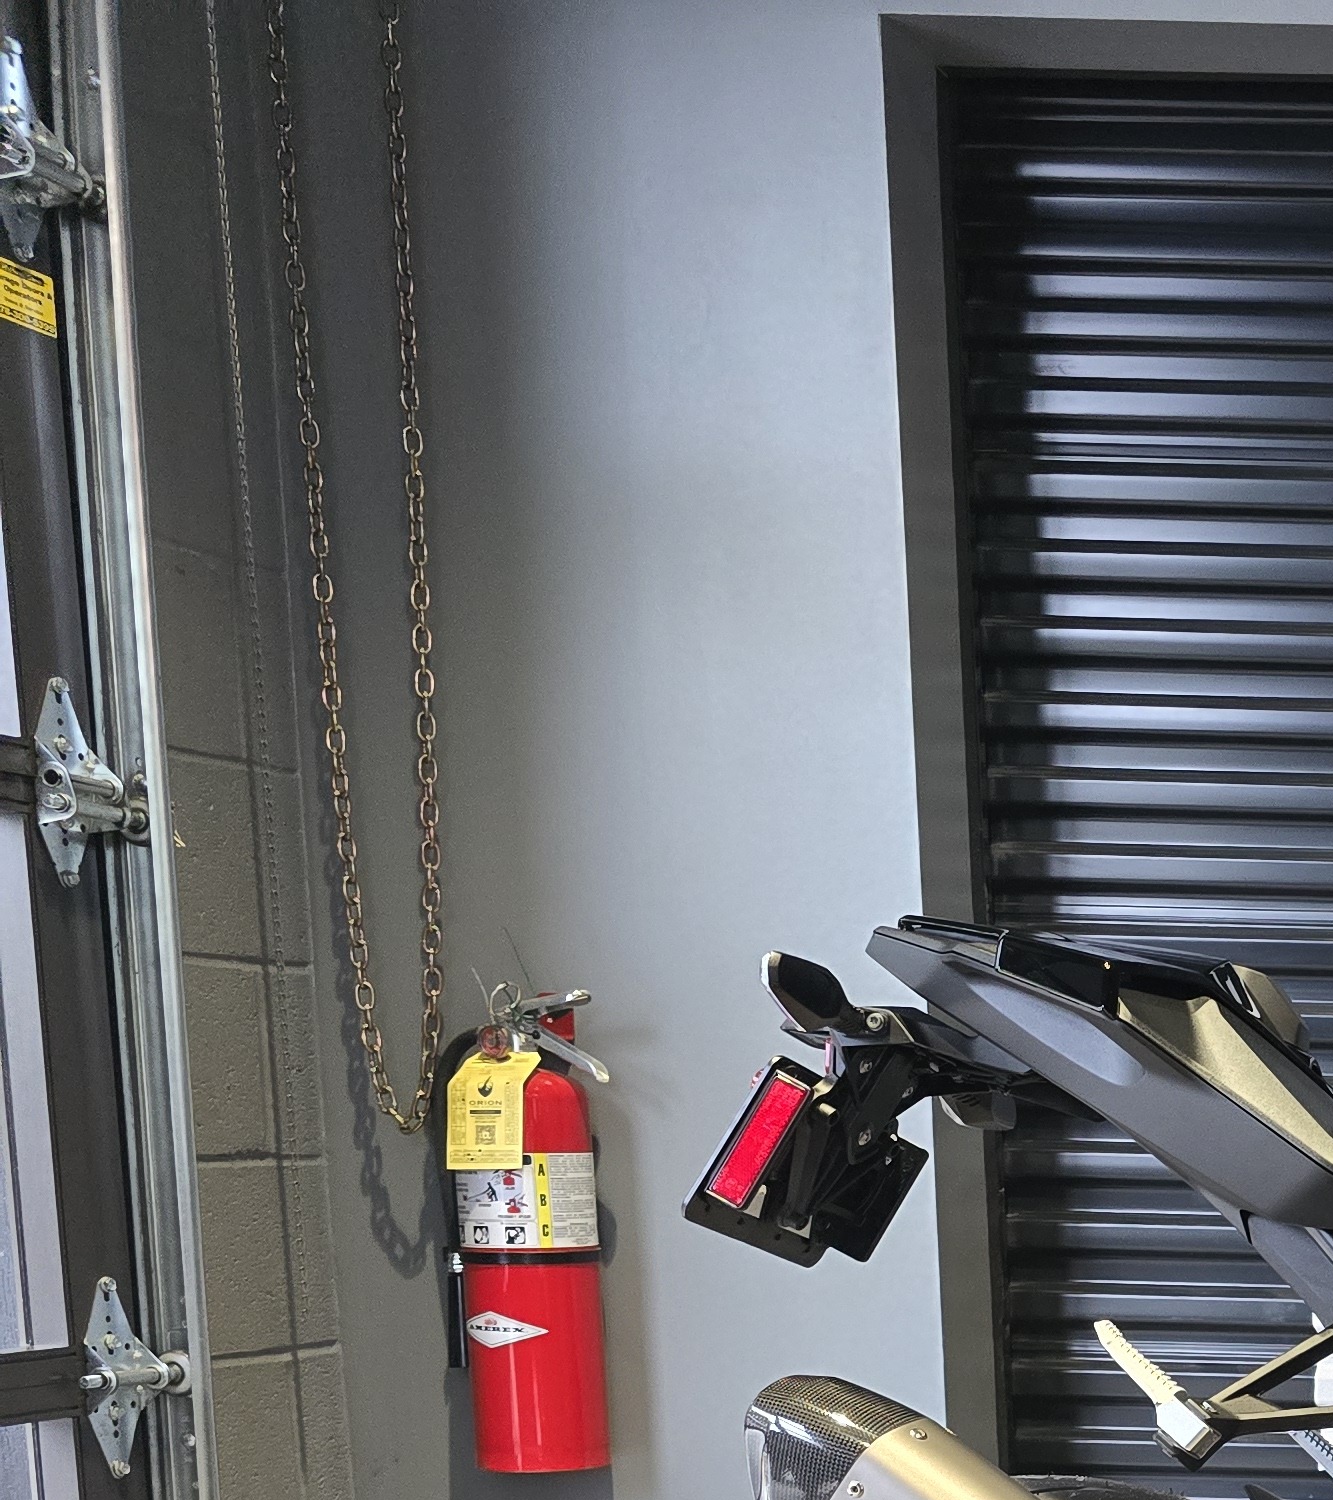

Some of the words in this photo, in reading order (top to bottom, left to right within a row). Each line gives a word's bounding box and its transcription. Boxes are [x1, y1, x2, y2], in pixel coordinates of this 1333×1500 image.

[537, 1164, 546, 1177] A
[539, 1194, 548, 1207] B
[542, 1224, 550, 1237] C
[469, 1324, 526, 1333] AMEREX
